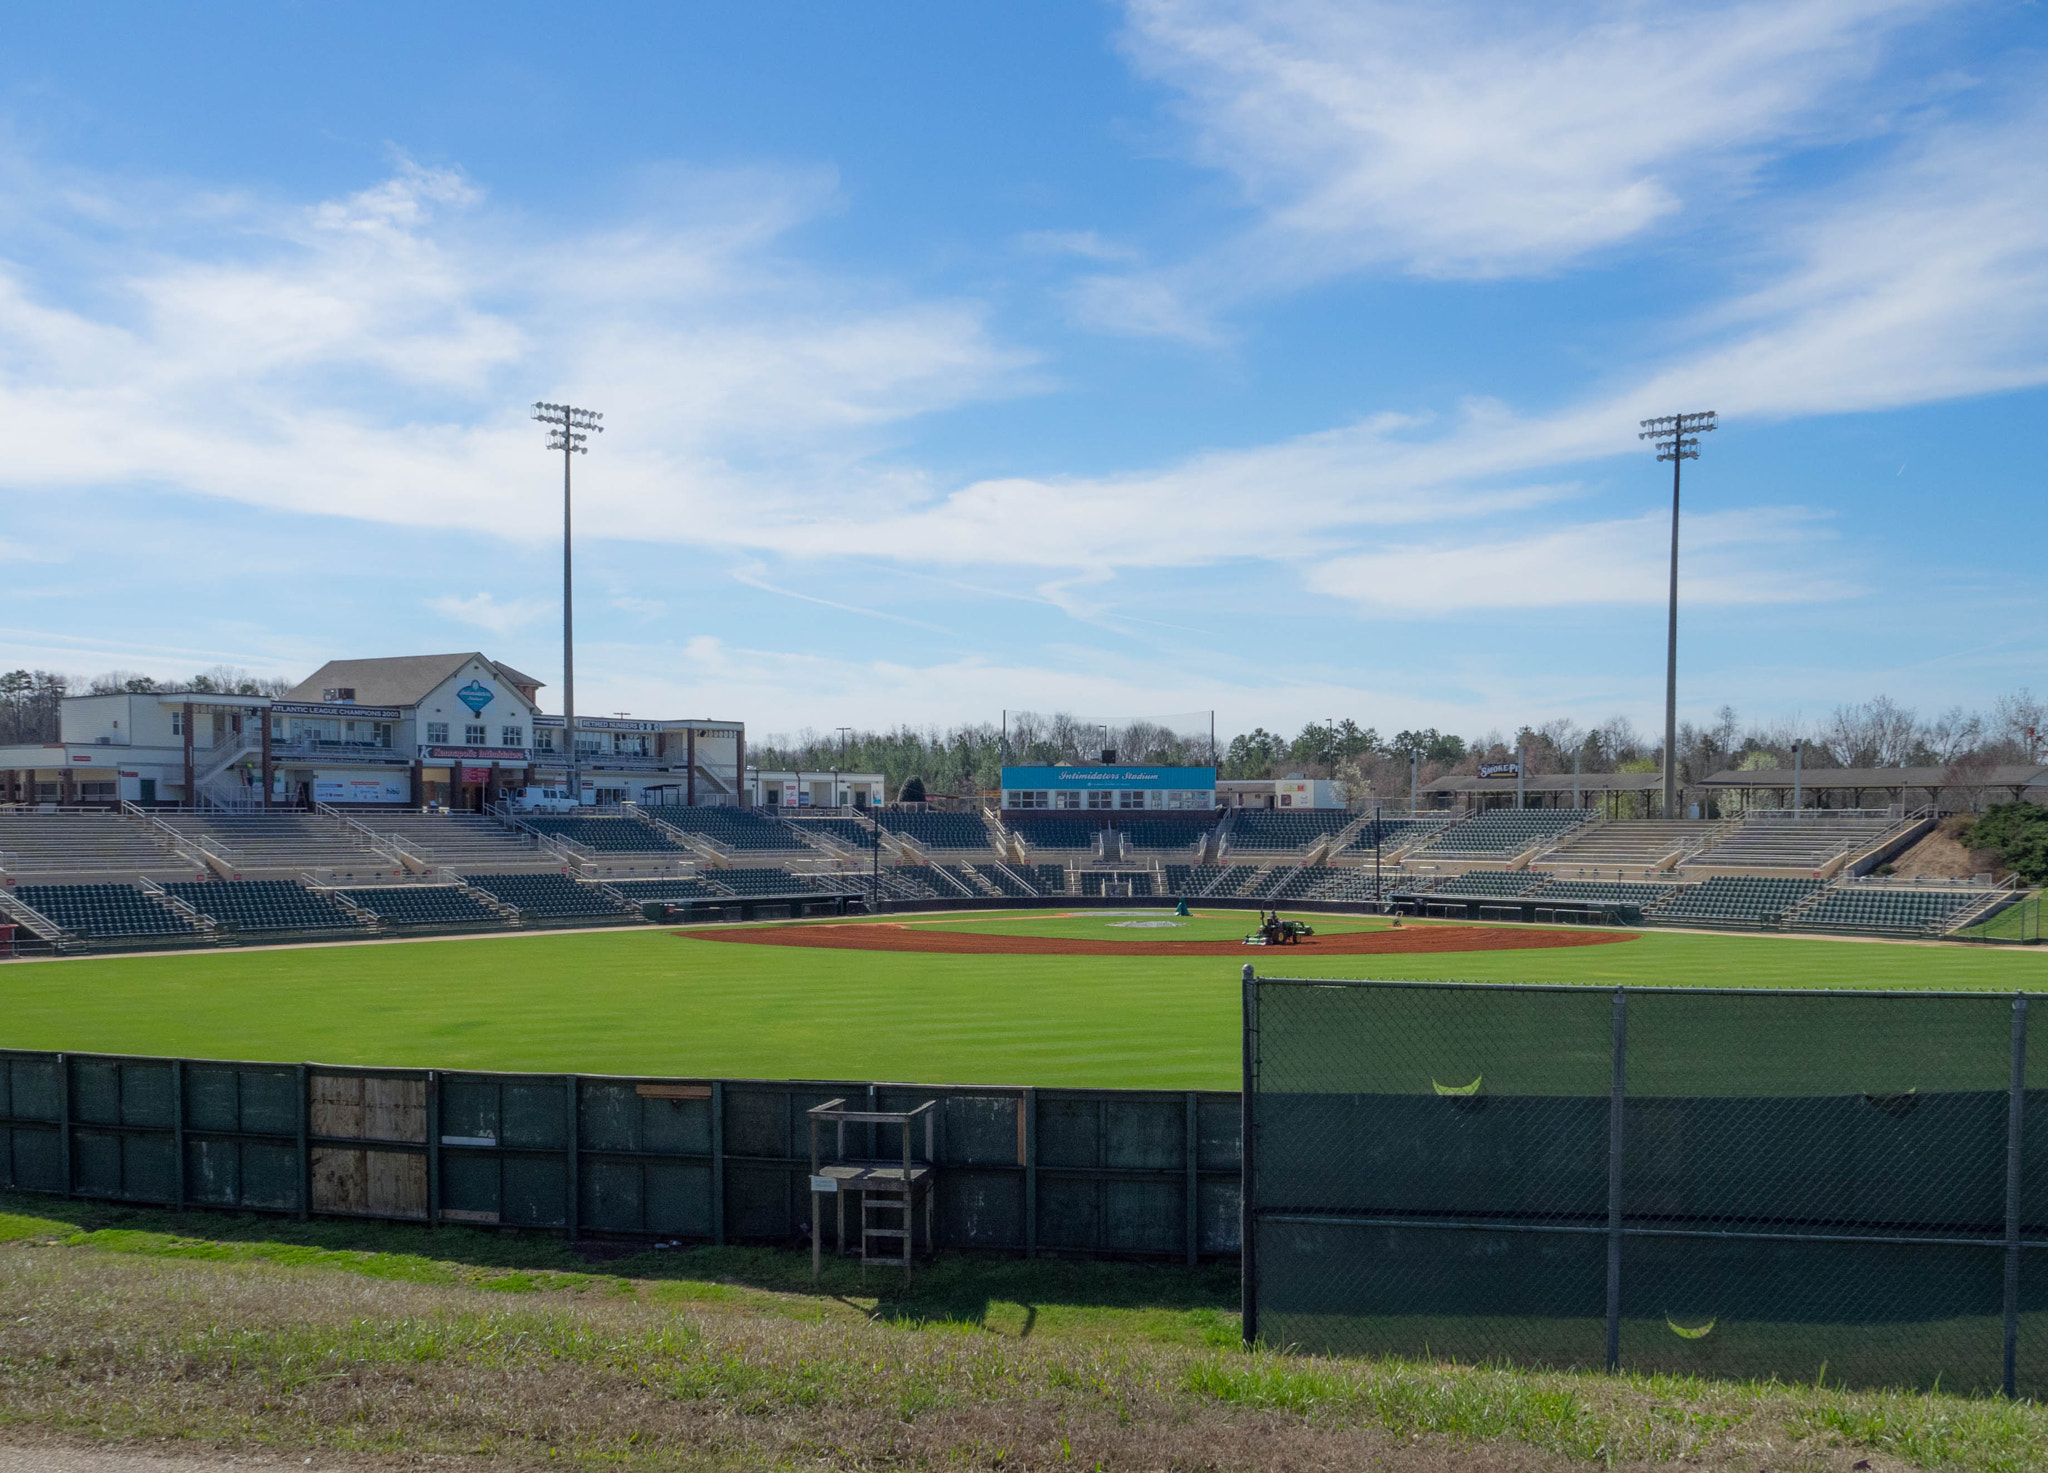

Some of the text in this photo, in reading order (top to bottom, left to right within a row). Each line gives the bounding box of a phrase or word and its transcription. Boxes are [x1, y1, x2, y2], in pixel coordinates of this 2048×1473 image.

[272, 705, 308, 713] ATLANTIC
[309, 707, 338, 715] LEAGUE
[339, 709, 381, 717] CHAMPIONS
[582, 720, 609, 729] RETIRED
[610, 721, 638, 730] NUMBERS
[1058, 771, 1158, 780] Intimidators Stadium
[1480, 765, 1508, 777] SMOKE
